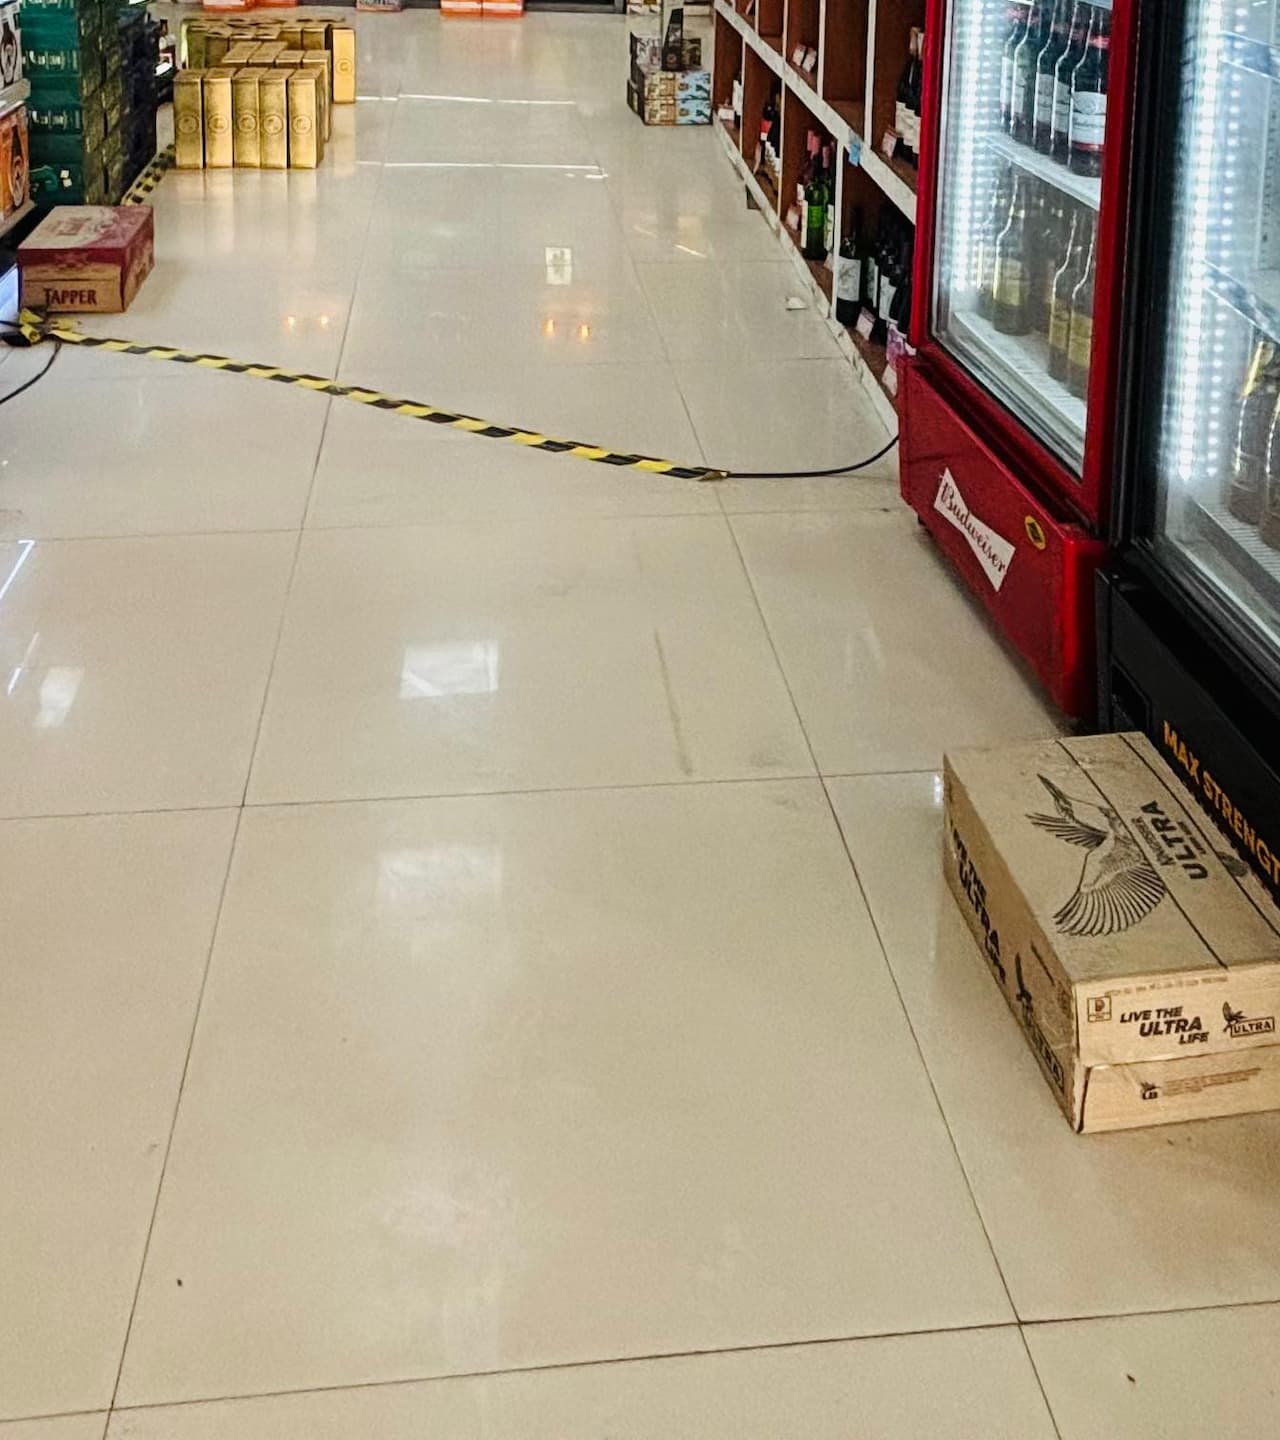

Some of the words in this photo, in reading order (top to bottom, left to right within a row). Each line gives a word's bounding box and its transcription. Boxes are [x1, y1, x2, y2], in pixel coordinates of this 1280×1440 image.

[44, 288, 97, 305] TAPPER
[941, 481, 1006, 573] Budweiser
[1163, 719, 1200, 784] MAX
[1141, 800, 1208, 880] ULTRA
[1120, 1009, 1151, 1023] LIVE
[1155, 1006, 1183, 1020] THE
[1139, 1017, 1203, 1037] ULTRA
[1233, 1021, 1272, 1034] ULTRA
[1178, 1032, 1209, 1045] LIFE
